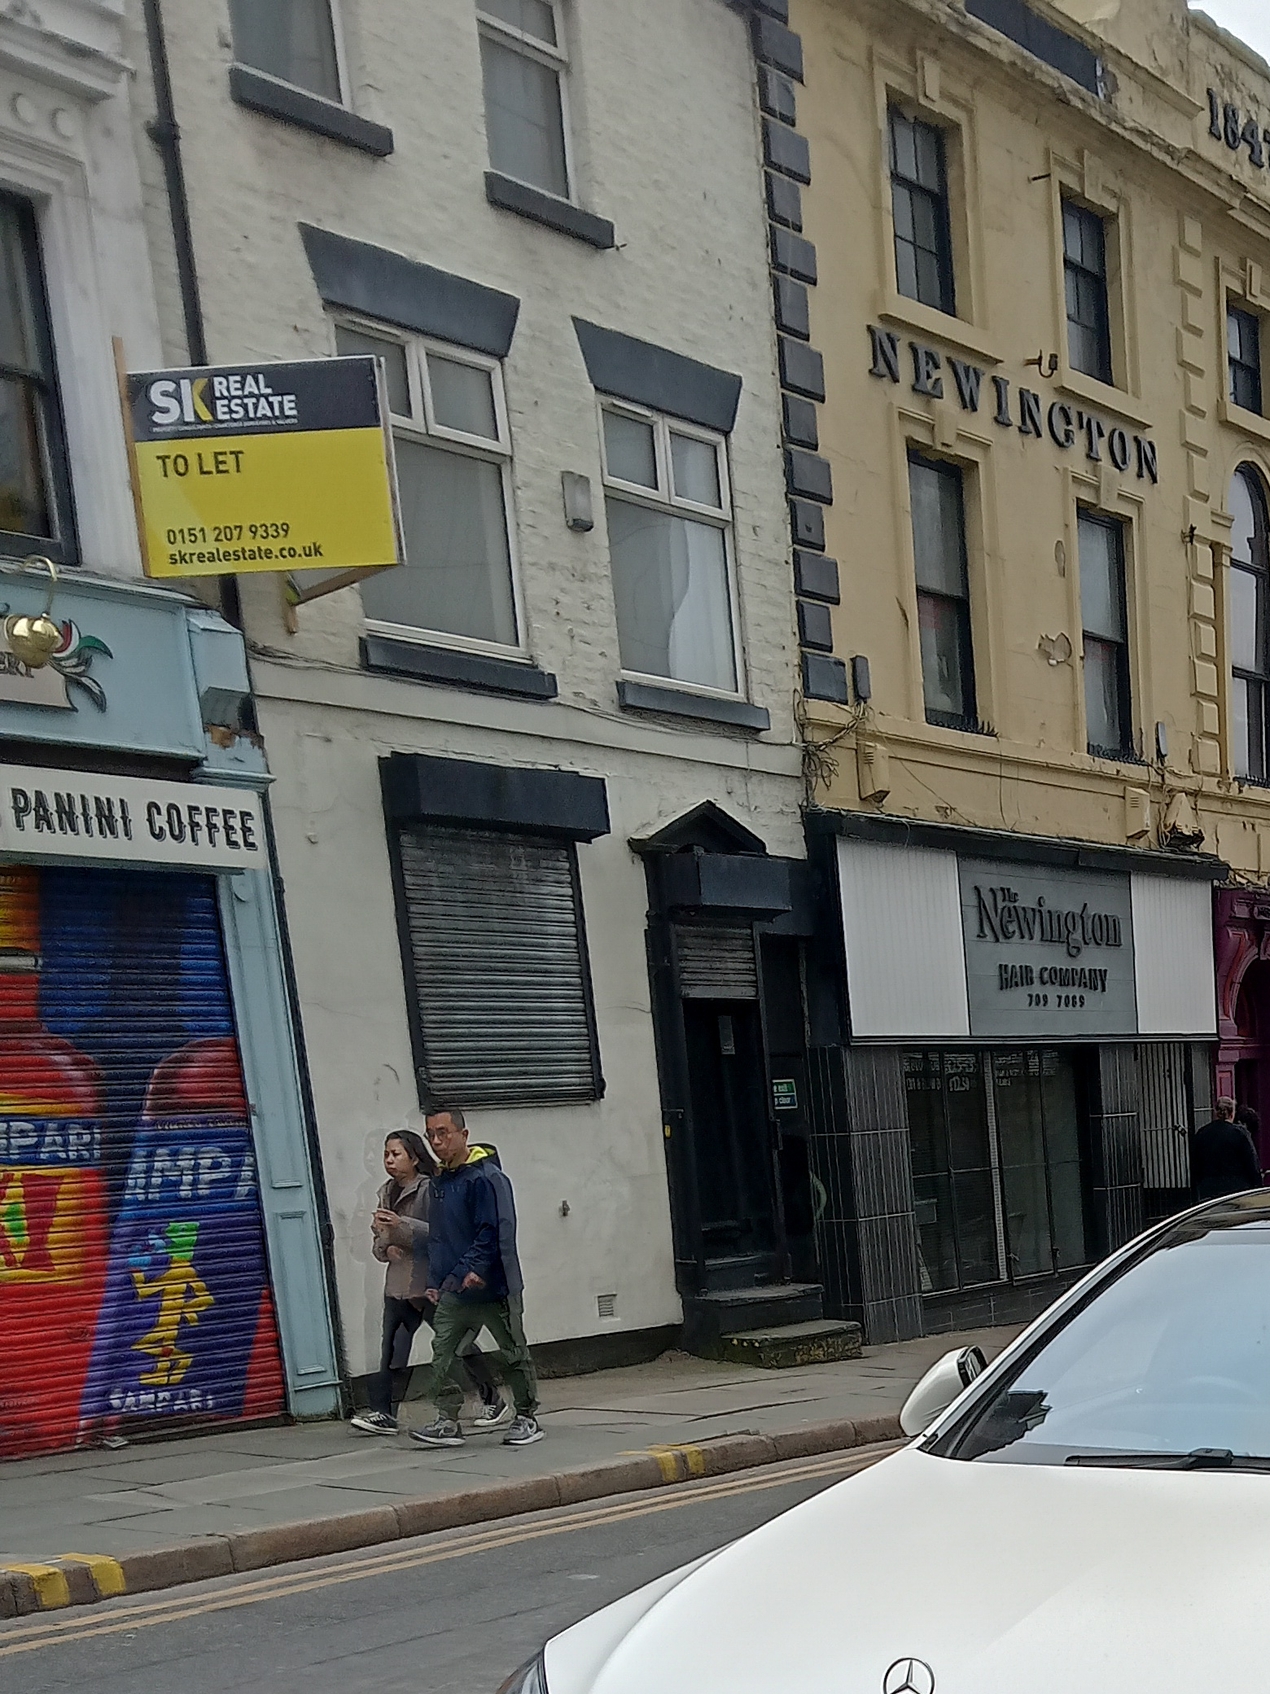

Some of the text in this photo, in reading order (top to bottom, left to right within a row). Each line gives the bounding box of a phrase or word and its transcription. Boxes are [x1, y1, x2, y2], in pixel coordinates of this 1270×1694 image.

[213, 373, 273, 398] REAL
[150, 377, 213, 424] SK
[215, 394, 298, 421] ESTATE
[866, 324, 1158, 485] NEWINGTON
[156, 450, 245, 478] TO LET
[167, 522, 290, 545] 0151 207 9339
[169, 541, 324, 565] skrealestate.co.uk
[10, 787, 258, 851] PANINI COFFEE
[974, 885, 1123, 958] Newington
[998, 963, 1109, 993] HAIR COMPANY
[1027, 993, 1049, 1007] 709
[0, 1120, 101, 1160] PARI
